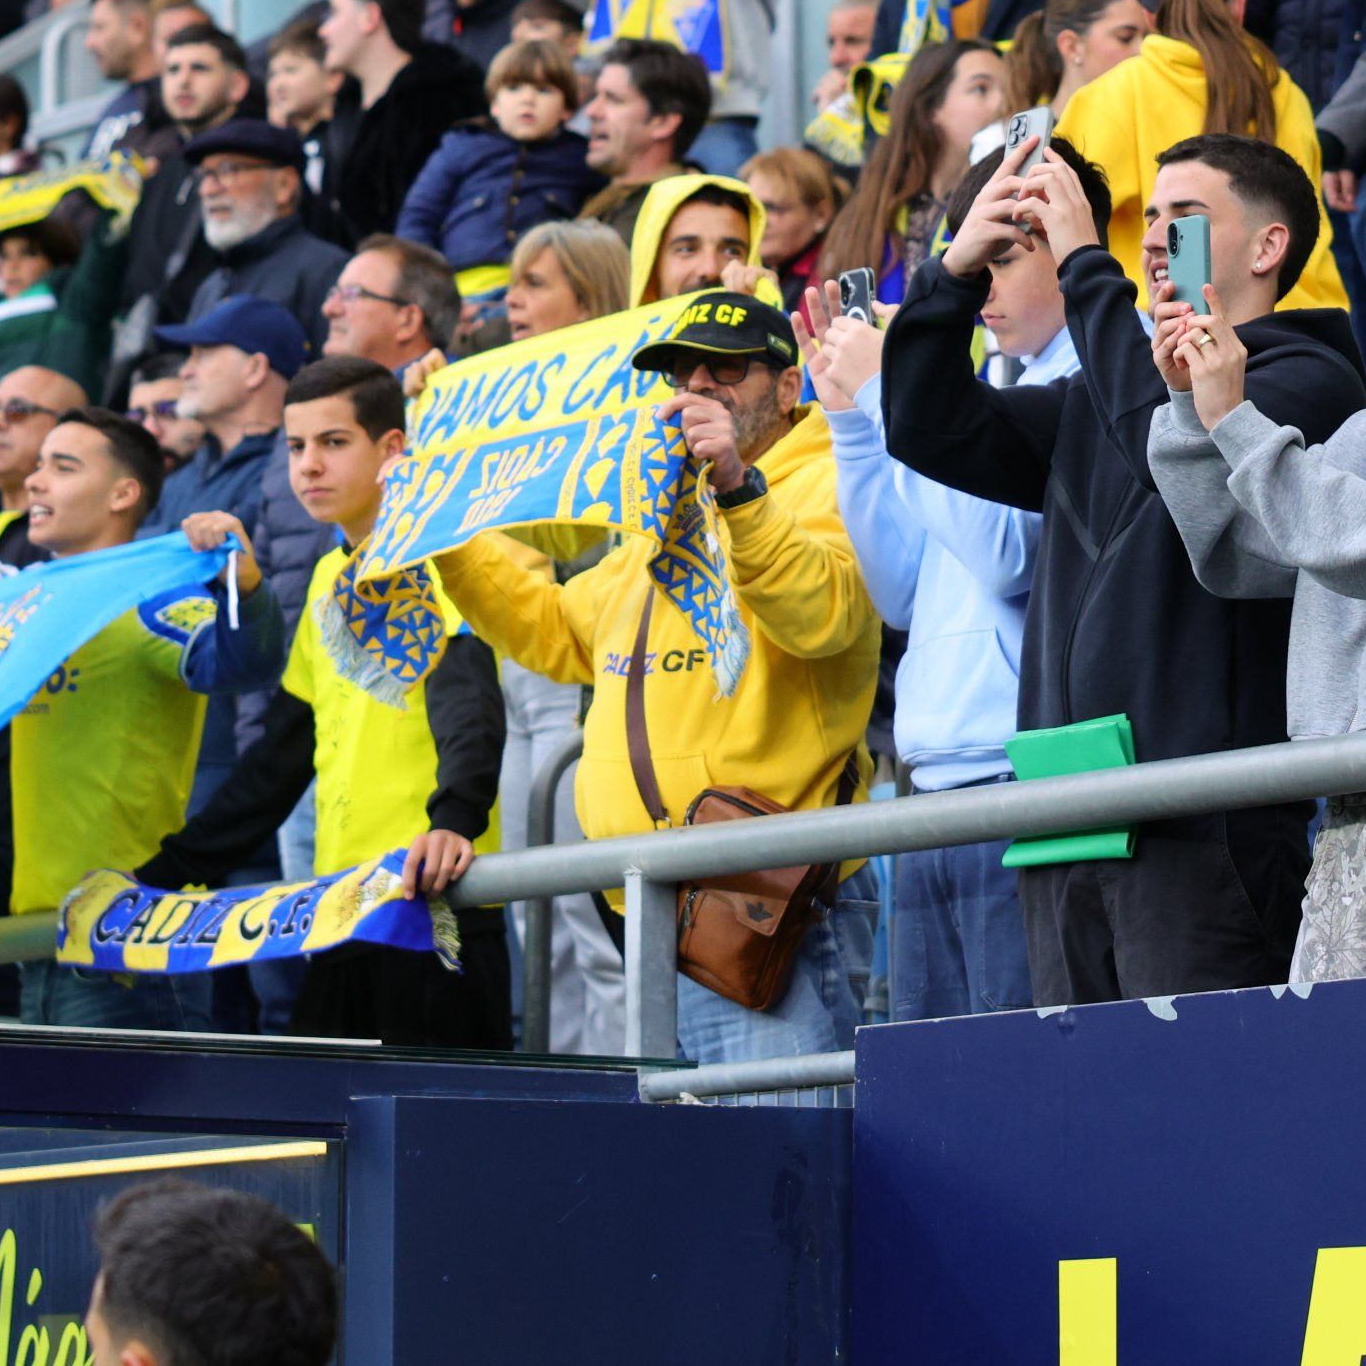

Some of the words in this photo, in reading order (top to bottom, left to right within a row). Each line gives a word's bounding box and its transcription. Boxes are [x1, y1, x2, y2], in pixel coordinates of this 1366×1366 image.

[715, 303, 748, 327] CF
[418, 352, 567, 448] VAMOS
[602, 651, 658, 677] CADZ
[661, 648, 706, 673] CF
[93, 890, 247, 947] CADIZ
